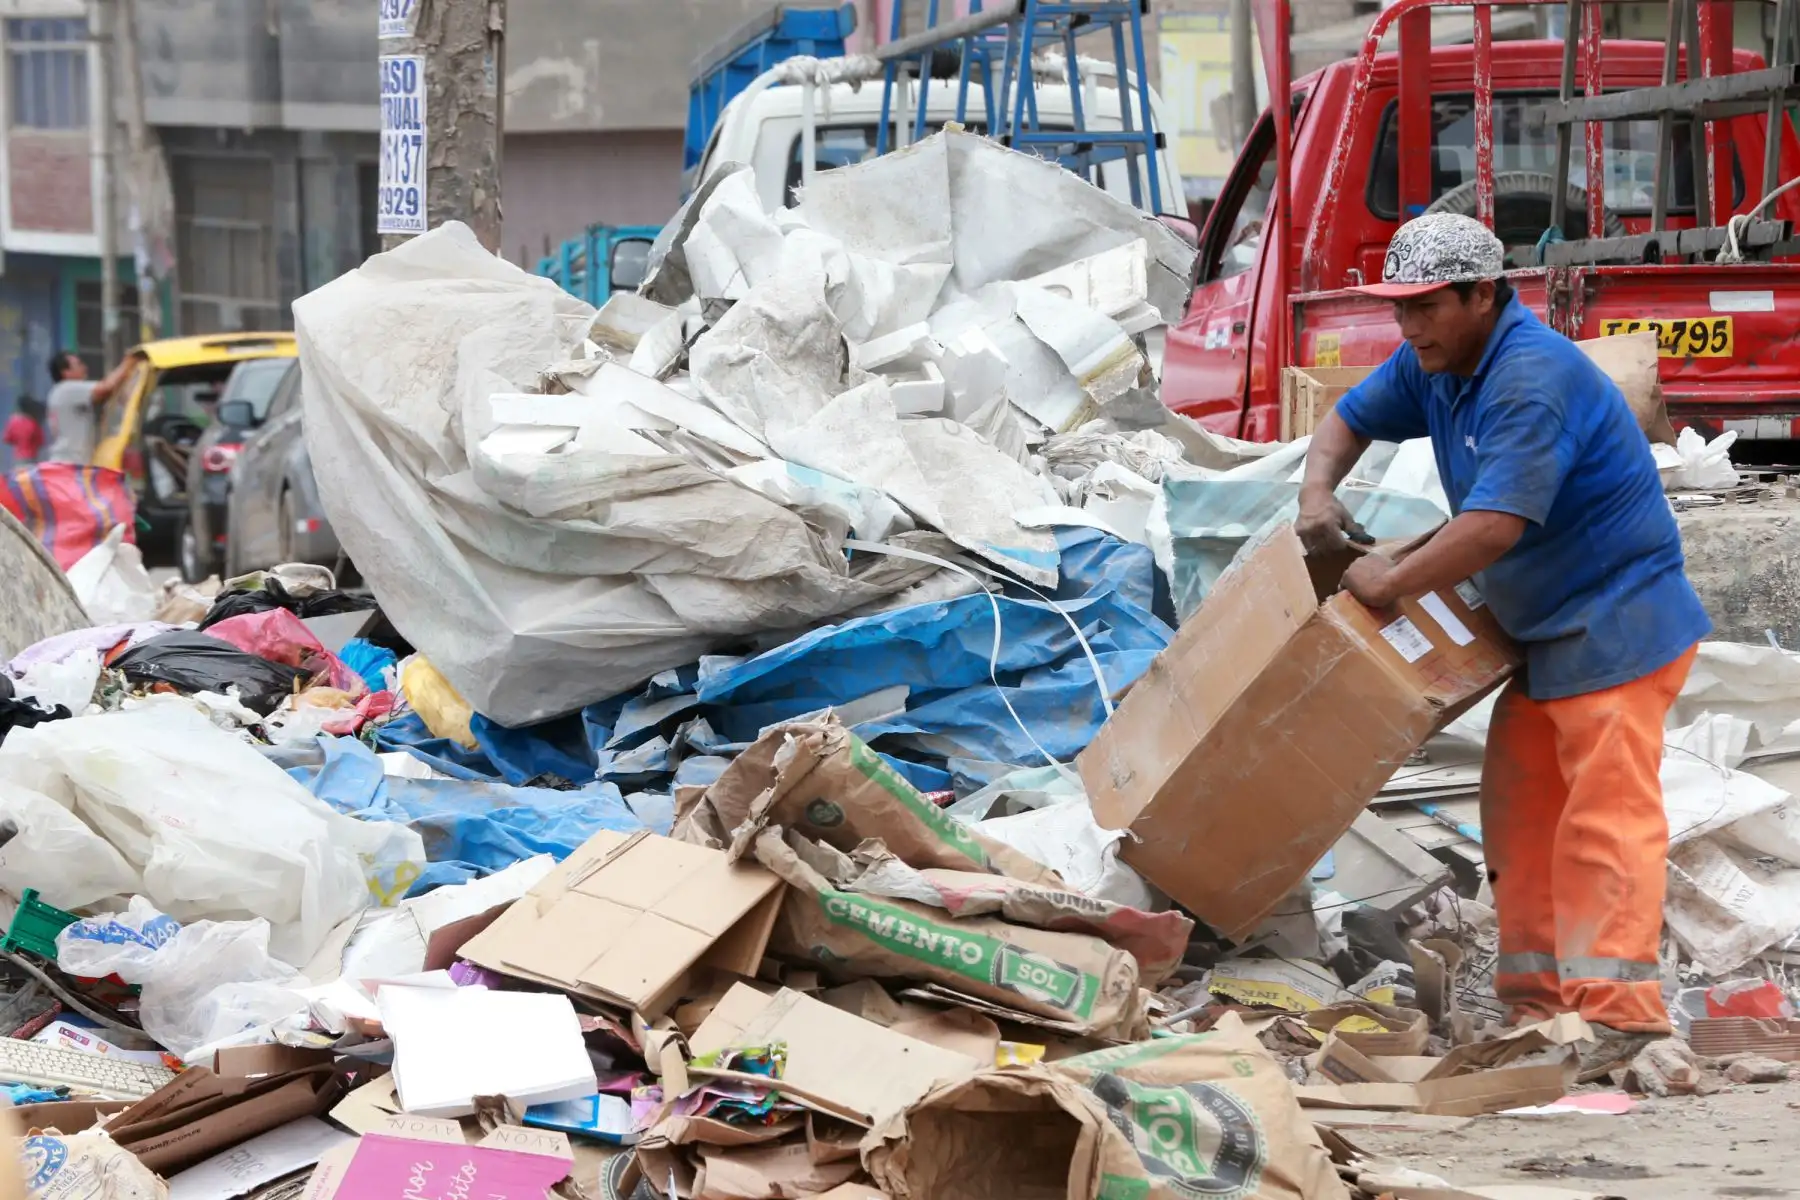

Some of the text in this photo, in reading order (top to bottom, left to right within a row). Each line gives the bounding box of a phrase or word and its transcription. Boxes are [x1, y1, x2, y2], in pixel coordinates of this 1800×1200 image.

[826, 897, 983, 965] CEMENTO
[1017, 963, 1059, 993] SOL
[1146, 1095, 1196, 1175] SOL
